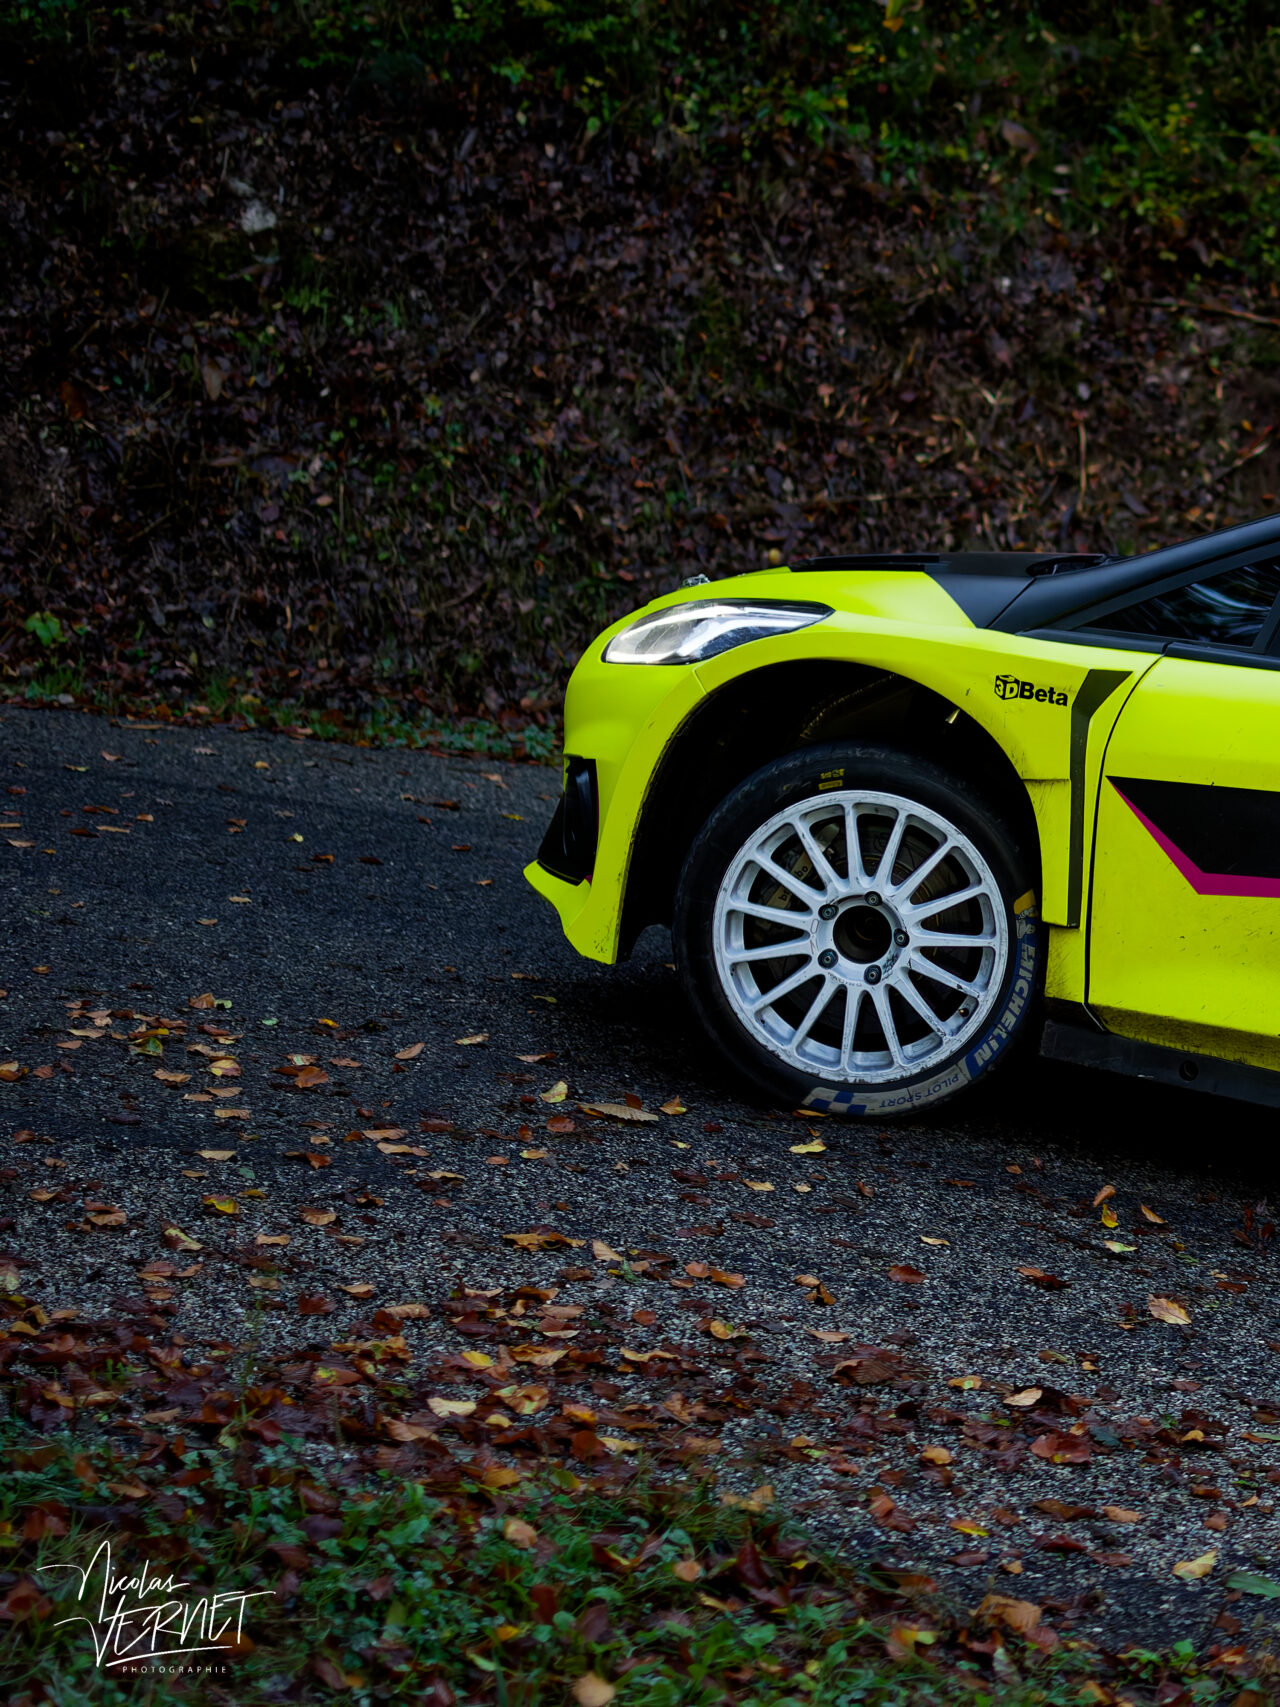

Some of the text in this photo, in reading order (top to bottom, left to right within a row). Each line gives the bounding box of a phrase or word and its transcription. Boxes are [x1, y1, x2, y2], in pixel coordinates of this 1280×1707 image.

[972, 942, 1036, 1068] MICHELIN
[878, 1073, 961, 1109] PILOT SPORT
